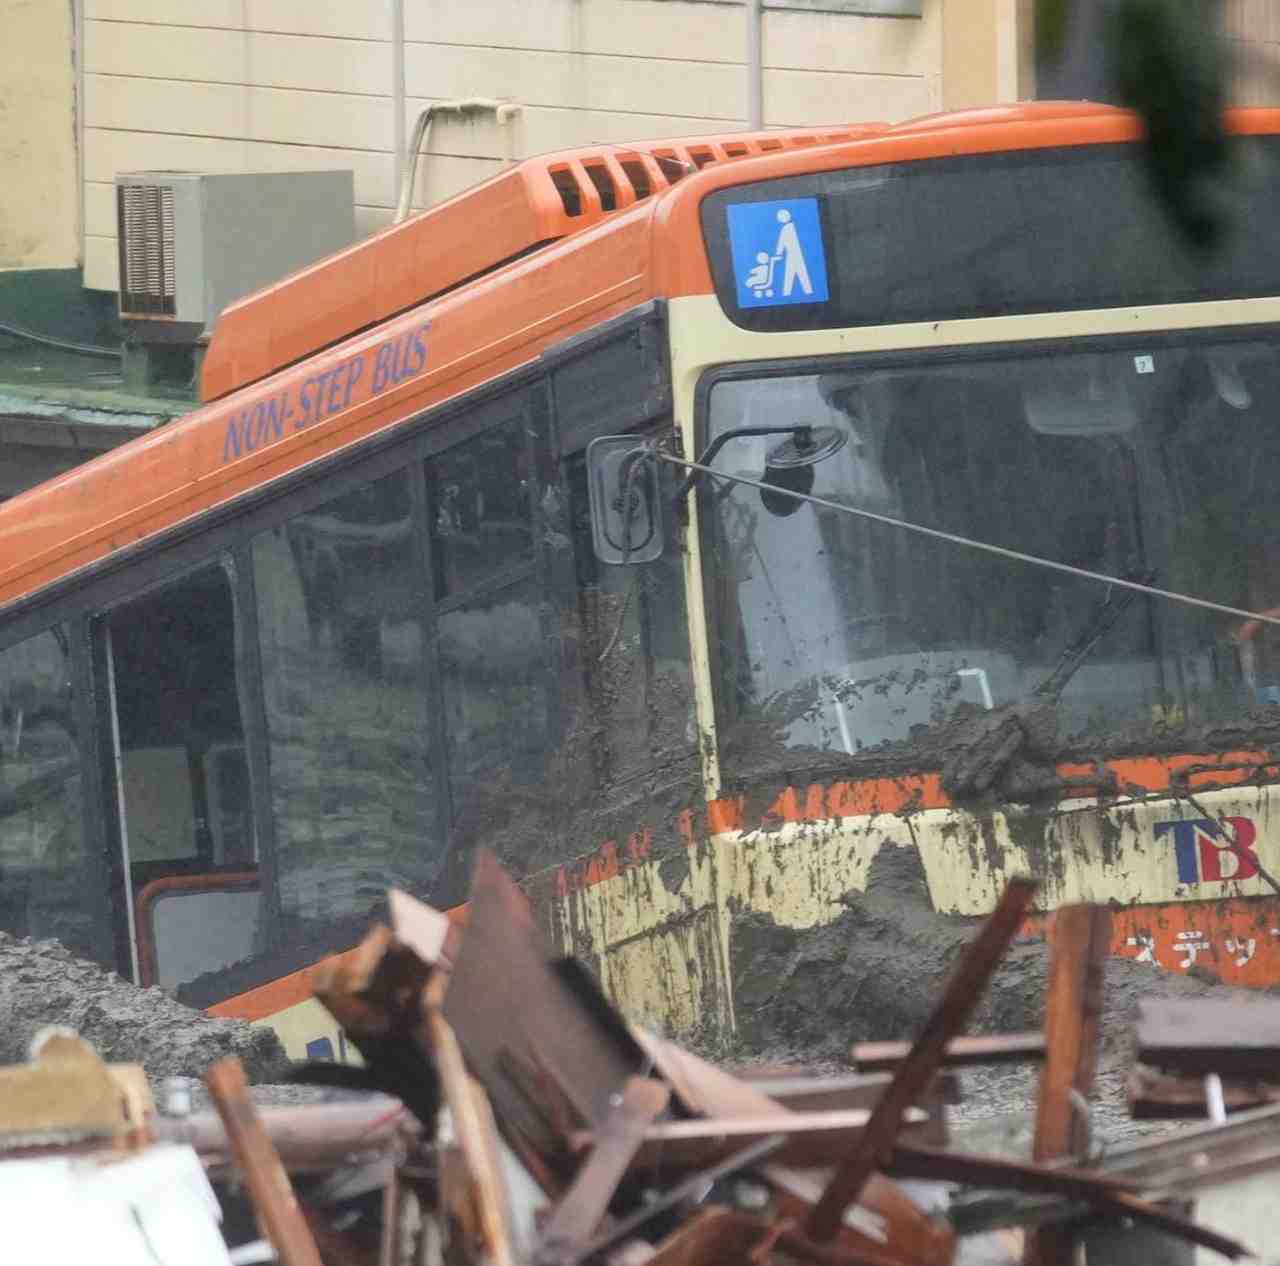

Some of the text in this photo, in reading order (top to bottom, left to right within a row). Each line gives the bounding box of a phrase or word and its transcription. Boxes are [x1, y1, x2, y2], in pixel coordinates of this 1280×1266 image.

[223, 322, 431, 463] NON-STEP BUS
[1153, 817, 1259, 884] TB
